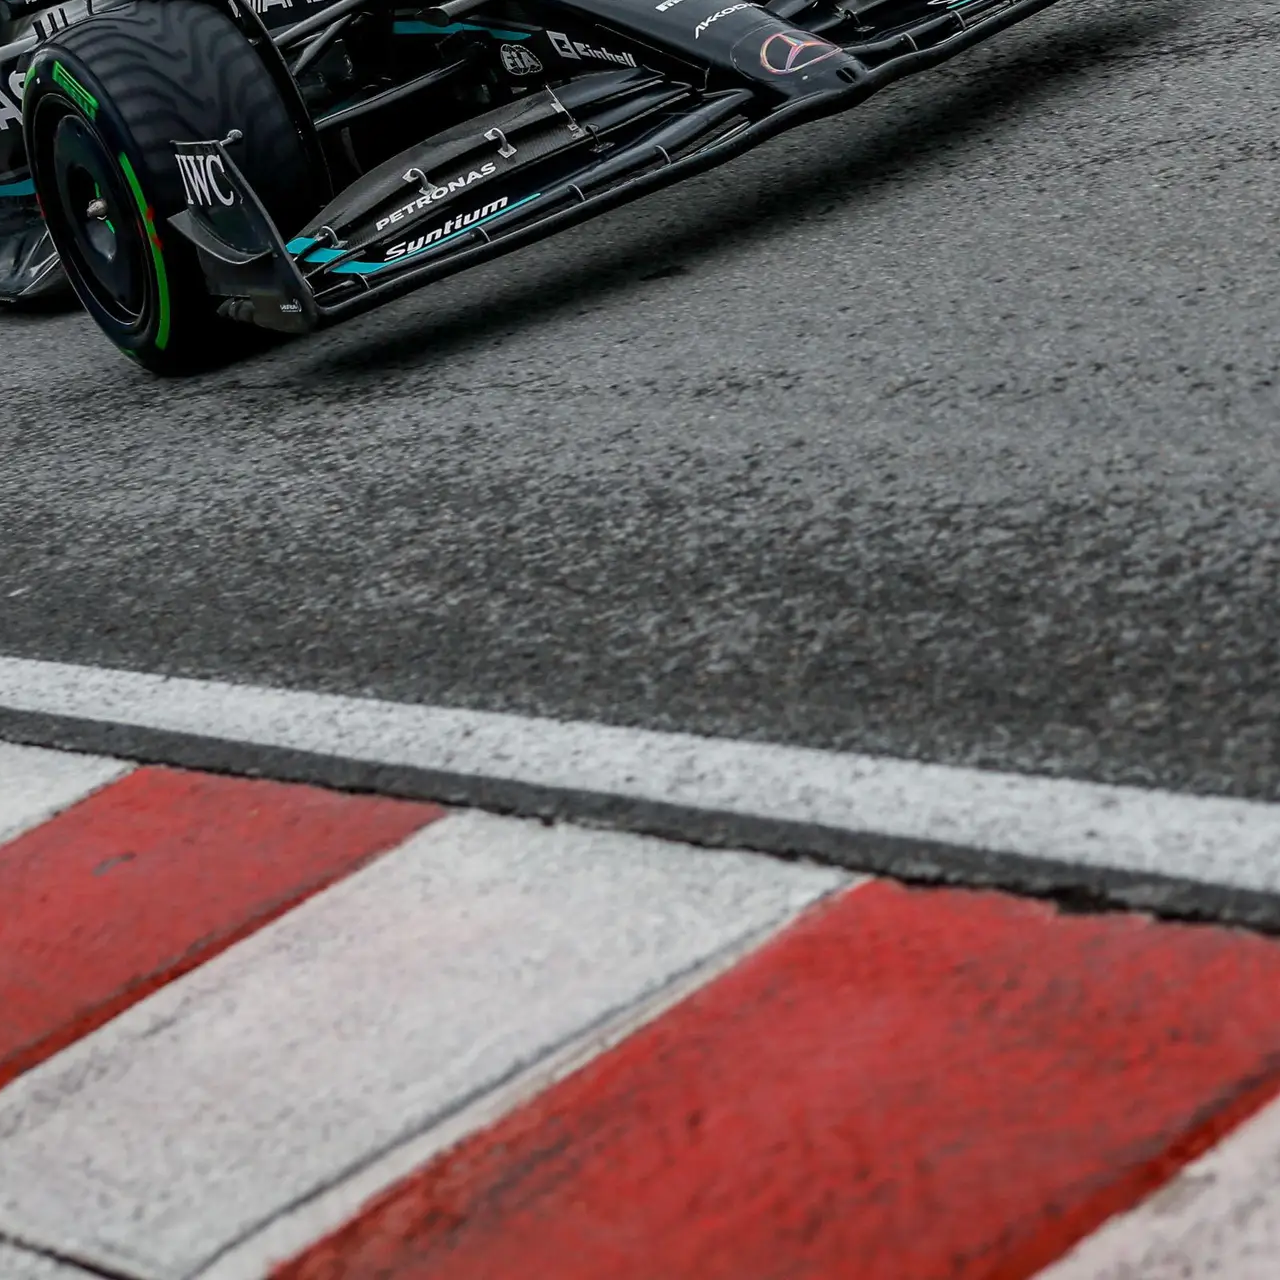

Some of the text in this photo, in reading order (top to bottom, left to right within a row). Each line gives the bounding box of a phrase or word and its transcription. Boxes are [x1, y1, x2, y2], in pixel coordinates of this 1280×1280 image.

[175, 154, 235, 206] IWC
[375, 162, 497, 232] PETRONAS
[384, 196, 509, 262] Syntium
